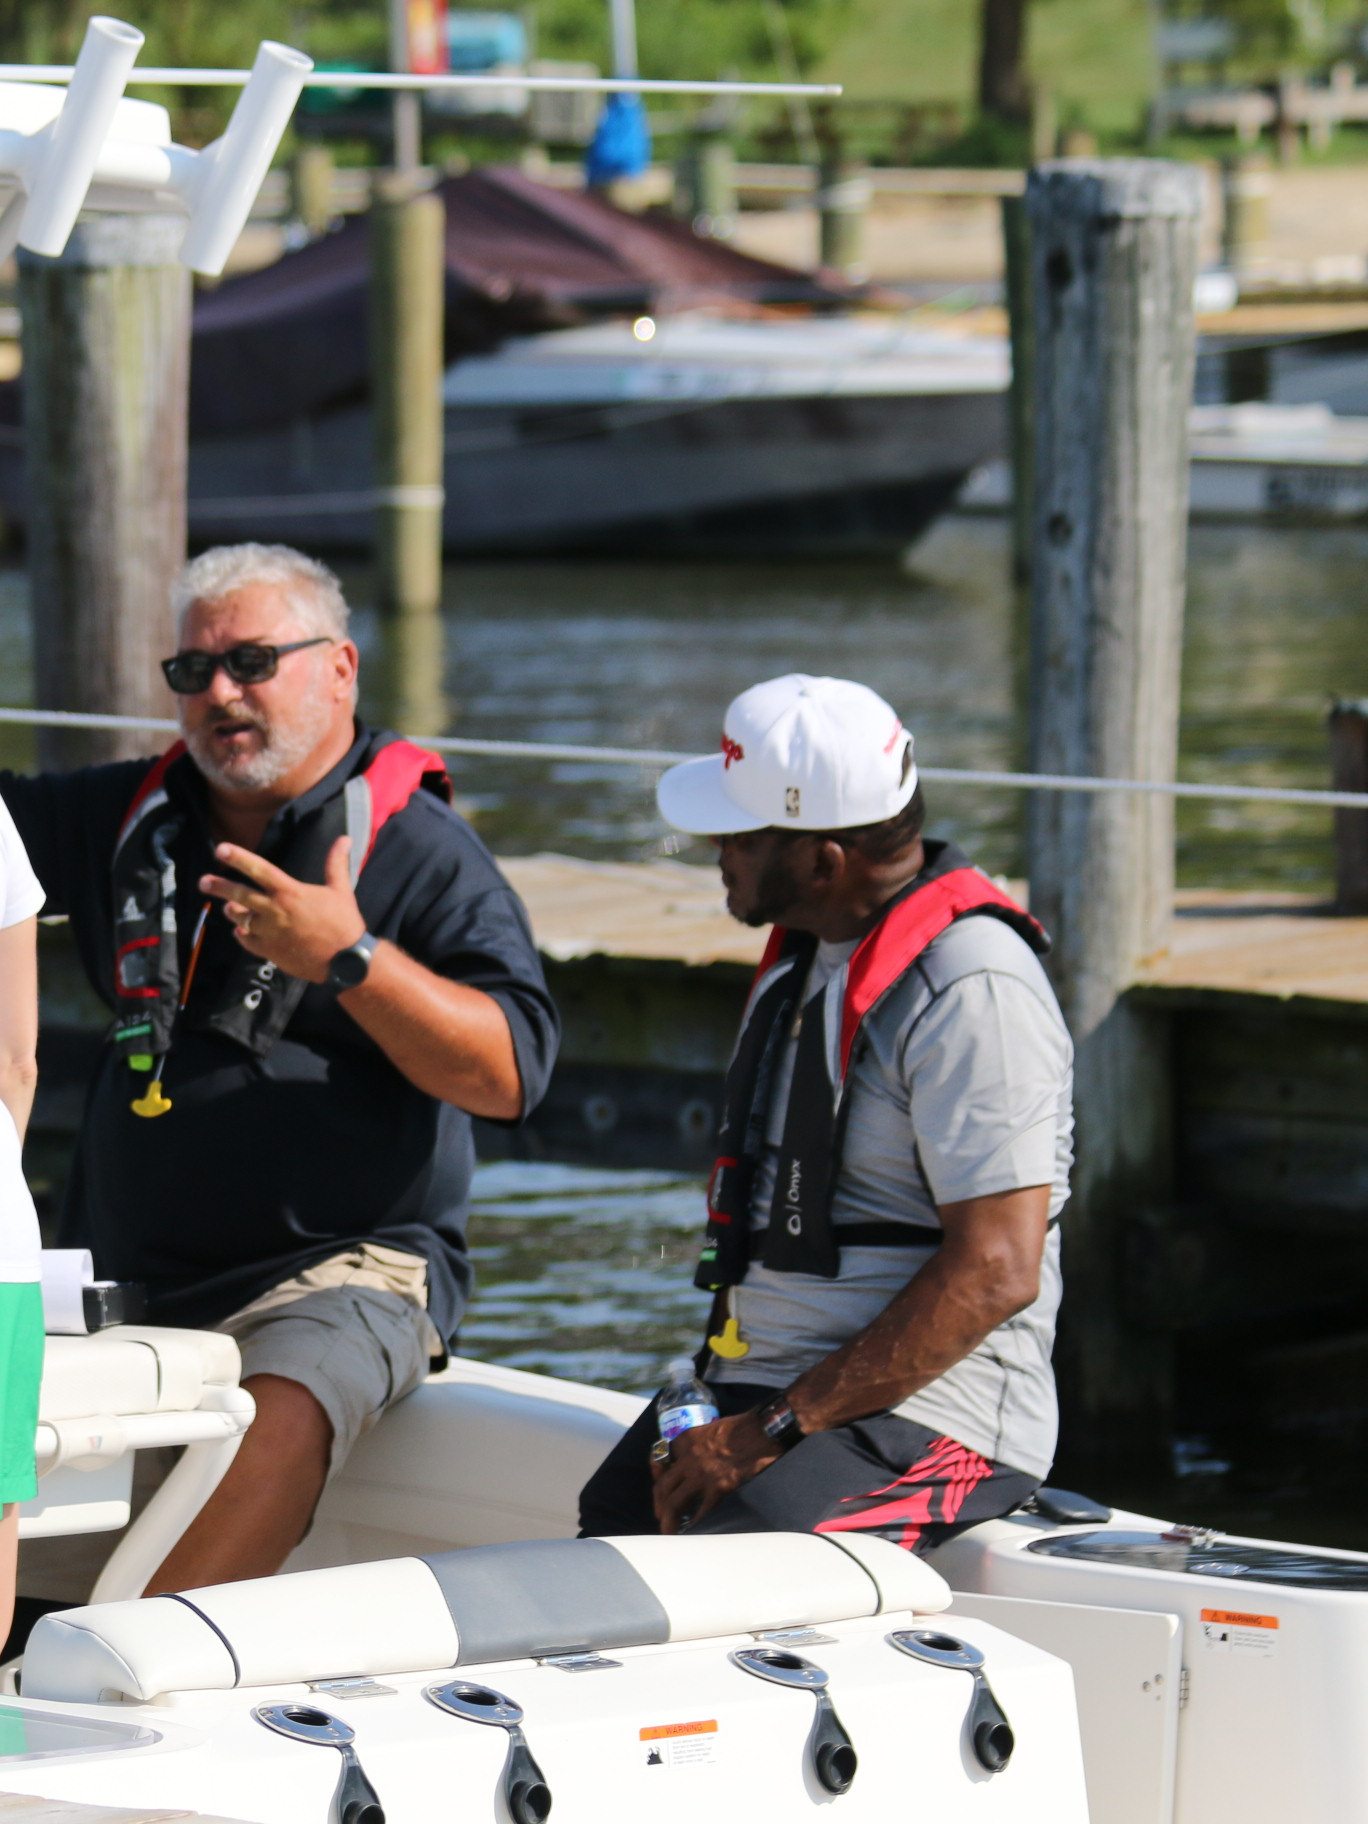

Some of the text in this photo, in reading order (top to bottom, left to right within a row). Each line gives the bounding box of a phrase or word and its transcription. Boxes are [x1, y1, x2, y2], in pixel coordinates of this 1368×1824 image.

[787, 1158, 802, 1202] Onyx
[1226, 1614, 1262, 1625] WARNING
[665, 1723, 703, 1735] WARNING
